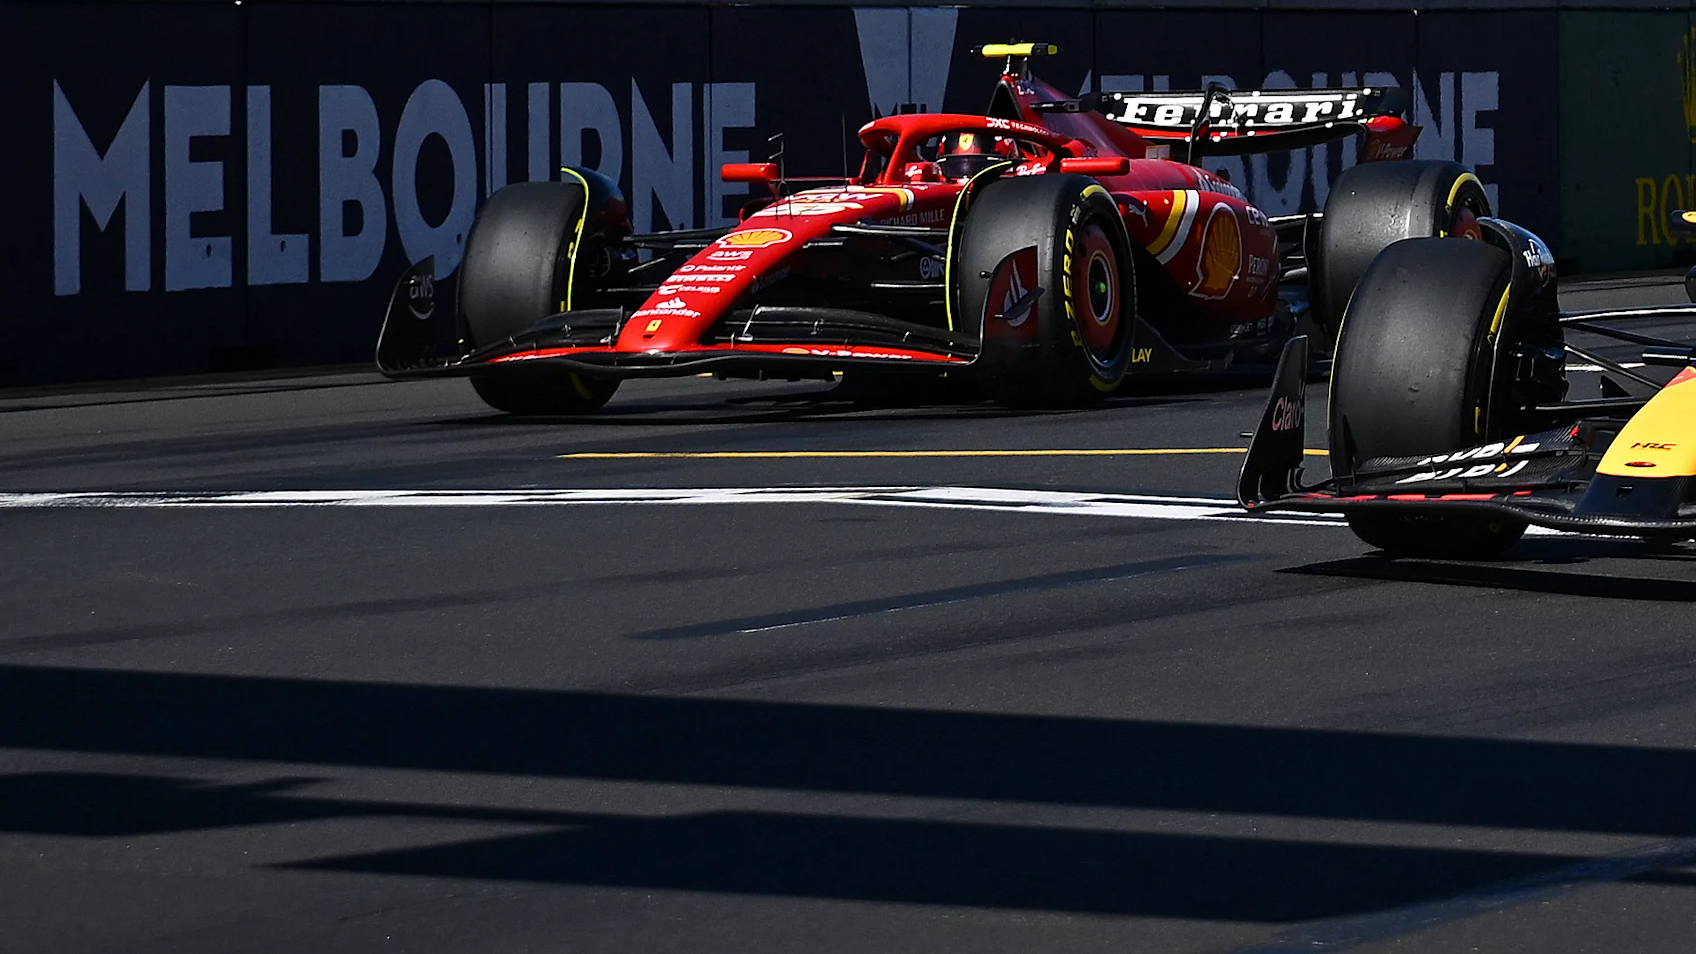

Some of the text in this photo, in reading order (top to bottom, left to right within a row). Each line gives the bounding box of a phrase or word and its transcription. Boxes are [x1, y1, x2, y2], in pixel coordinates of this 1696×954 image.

[1116, 93, 1365, 125] Ferrari
[920, 208, 945, 224] MILLE
[694, 264, 746, 273] Palantir
[1271, 396, 1301, 432] Claro
